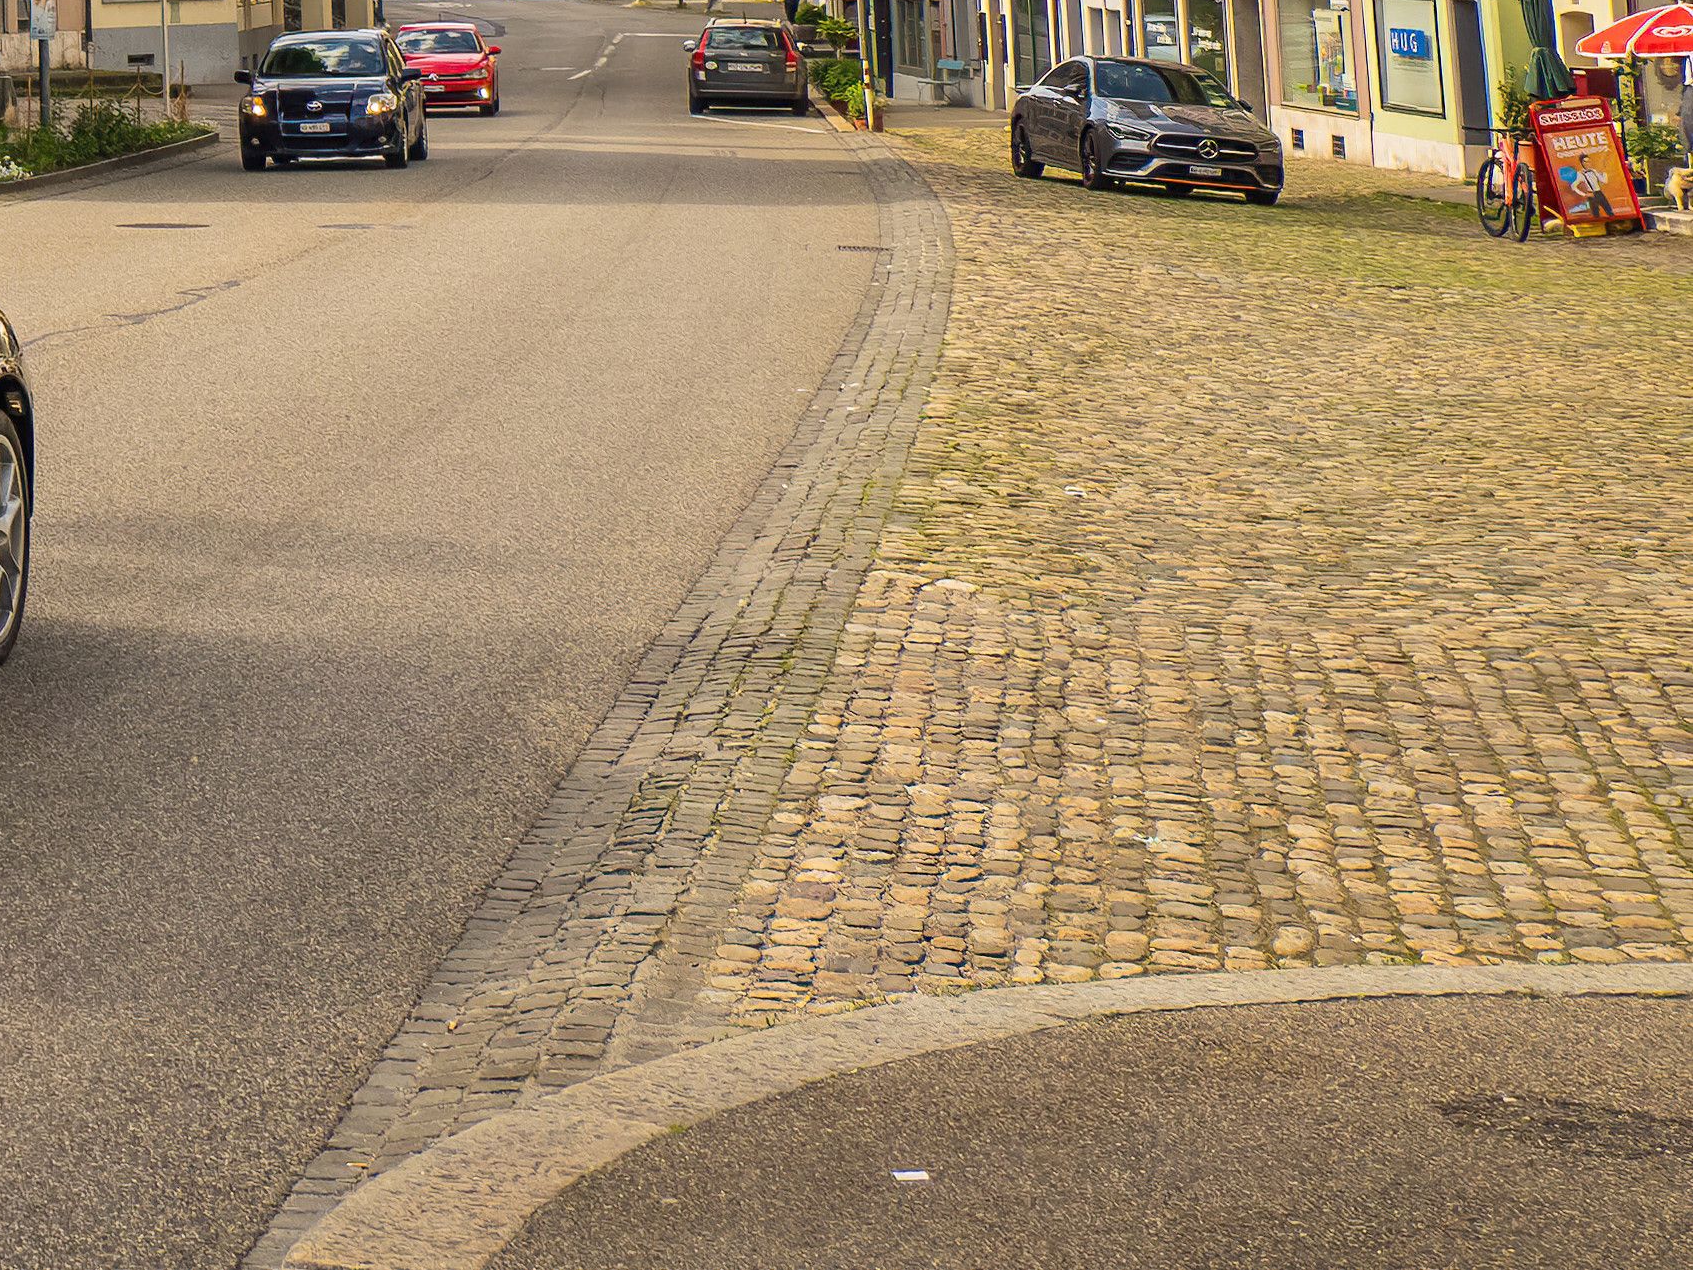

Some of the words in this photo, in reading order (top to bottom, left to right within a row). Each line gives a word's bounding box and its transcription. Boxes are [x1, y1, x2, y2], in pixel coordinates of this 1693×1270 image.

[1391, 32, 1418, 53] HUG
[1540, 109, 1602, 125] SWISSLOS
[1552, 131, 1609, 151] HEUTE
